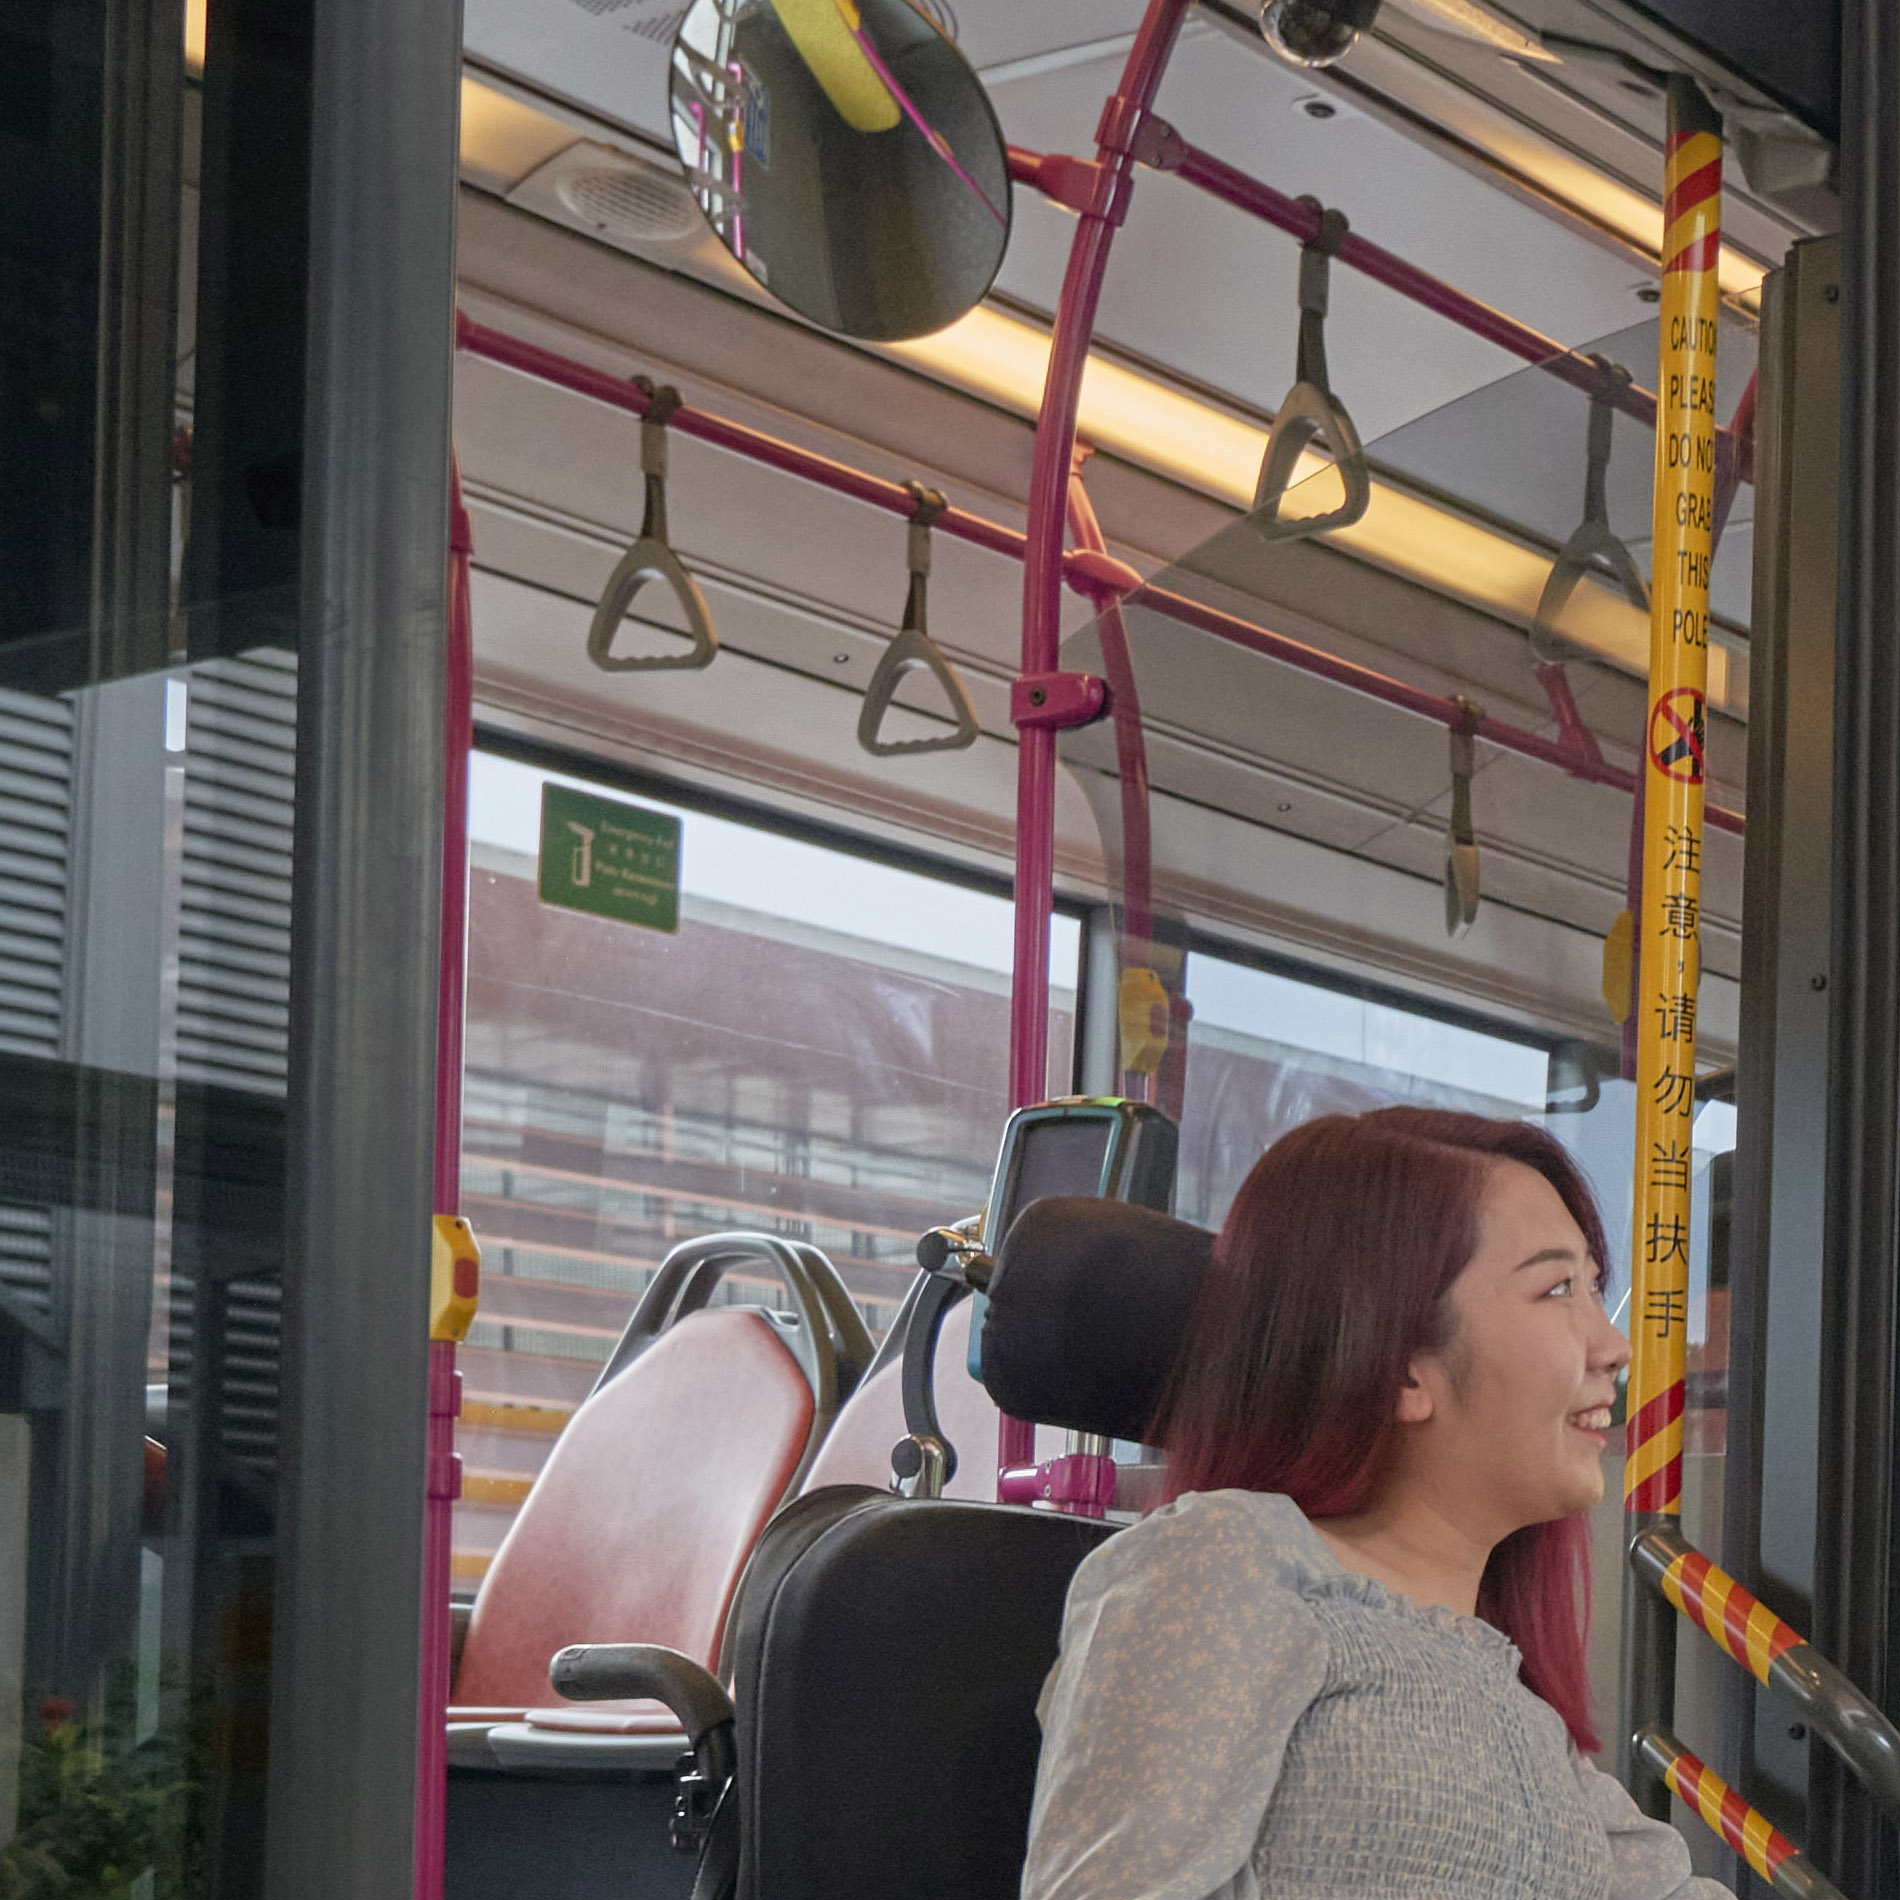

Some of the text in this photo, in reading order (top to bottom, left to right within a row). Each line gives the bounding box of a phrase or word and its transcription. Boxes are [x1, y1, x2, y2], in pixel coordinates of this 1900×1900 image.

[1670, 315, 1717, 357] CAUTIO
[1669, 373, 1715, 415] PLEAS
[1669, 433, 1713, 475] DO NO
[1677, 551, 1709, 590] THIS
[1672, 608, 1708, 650] POLE
